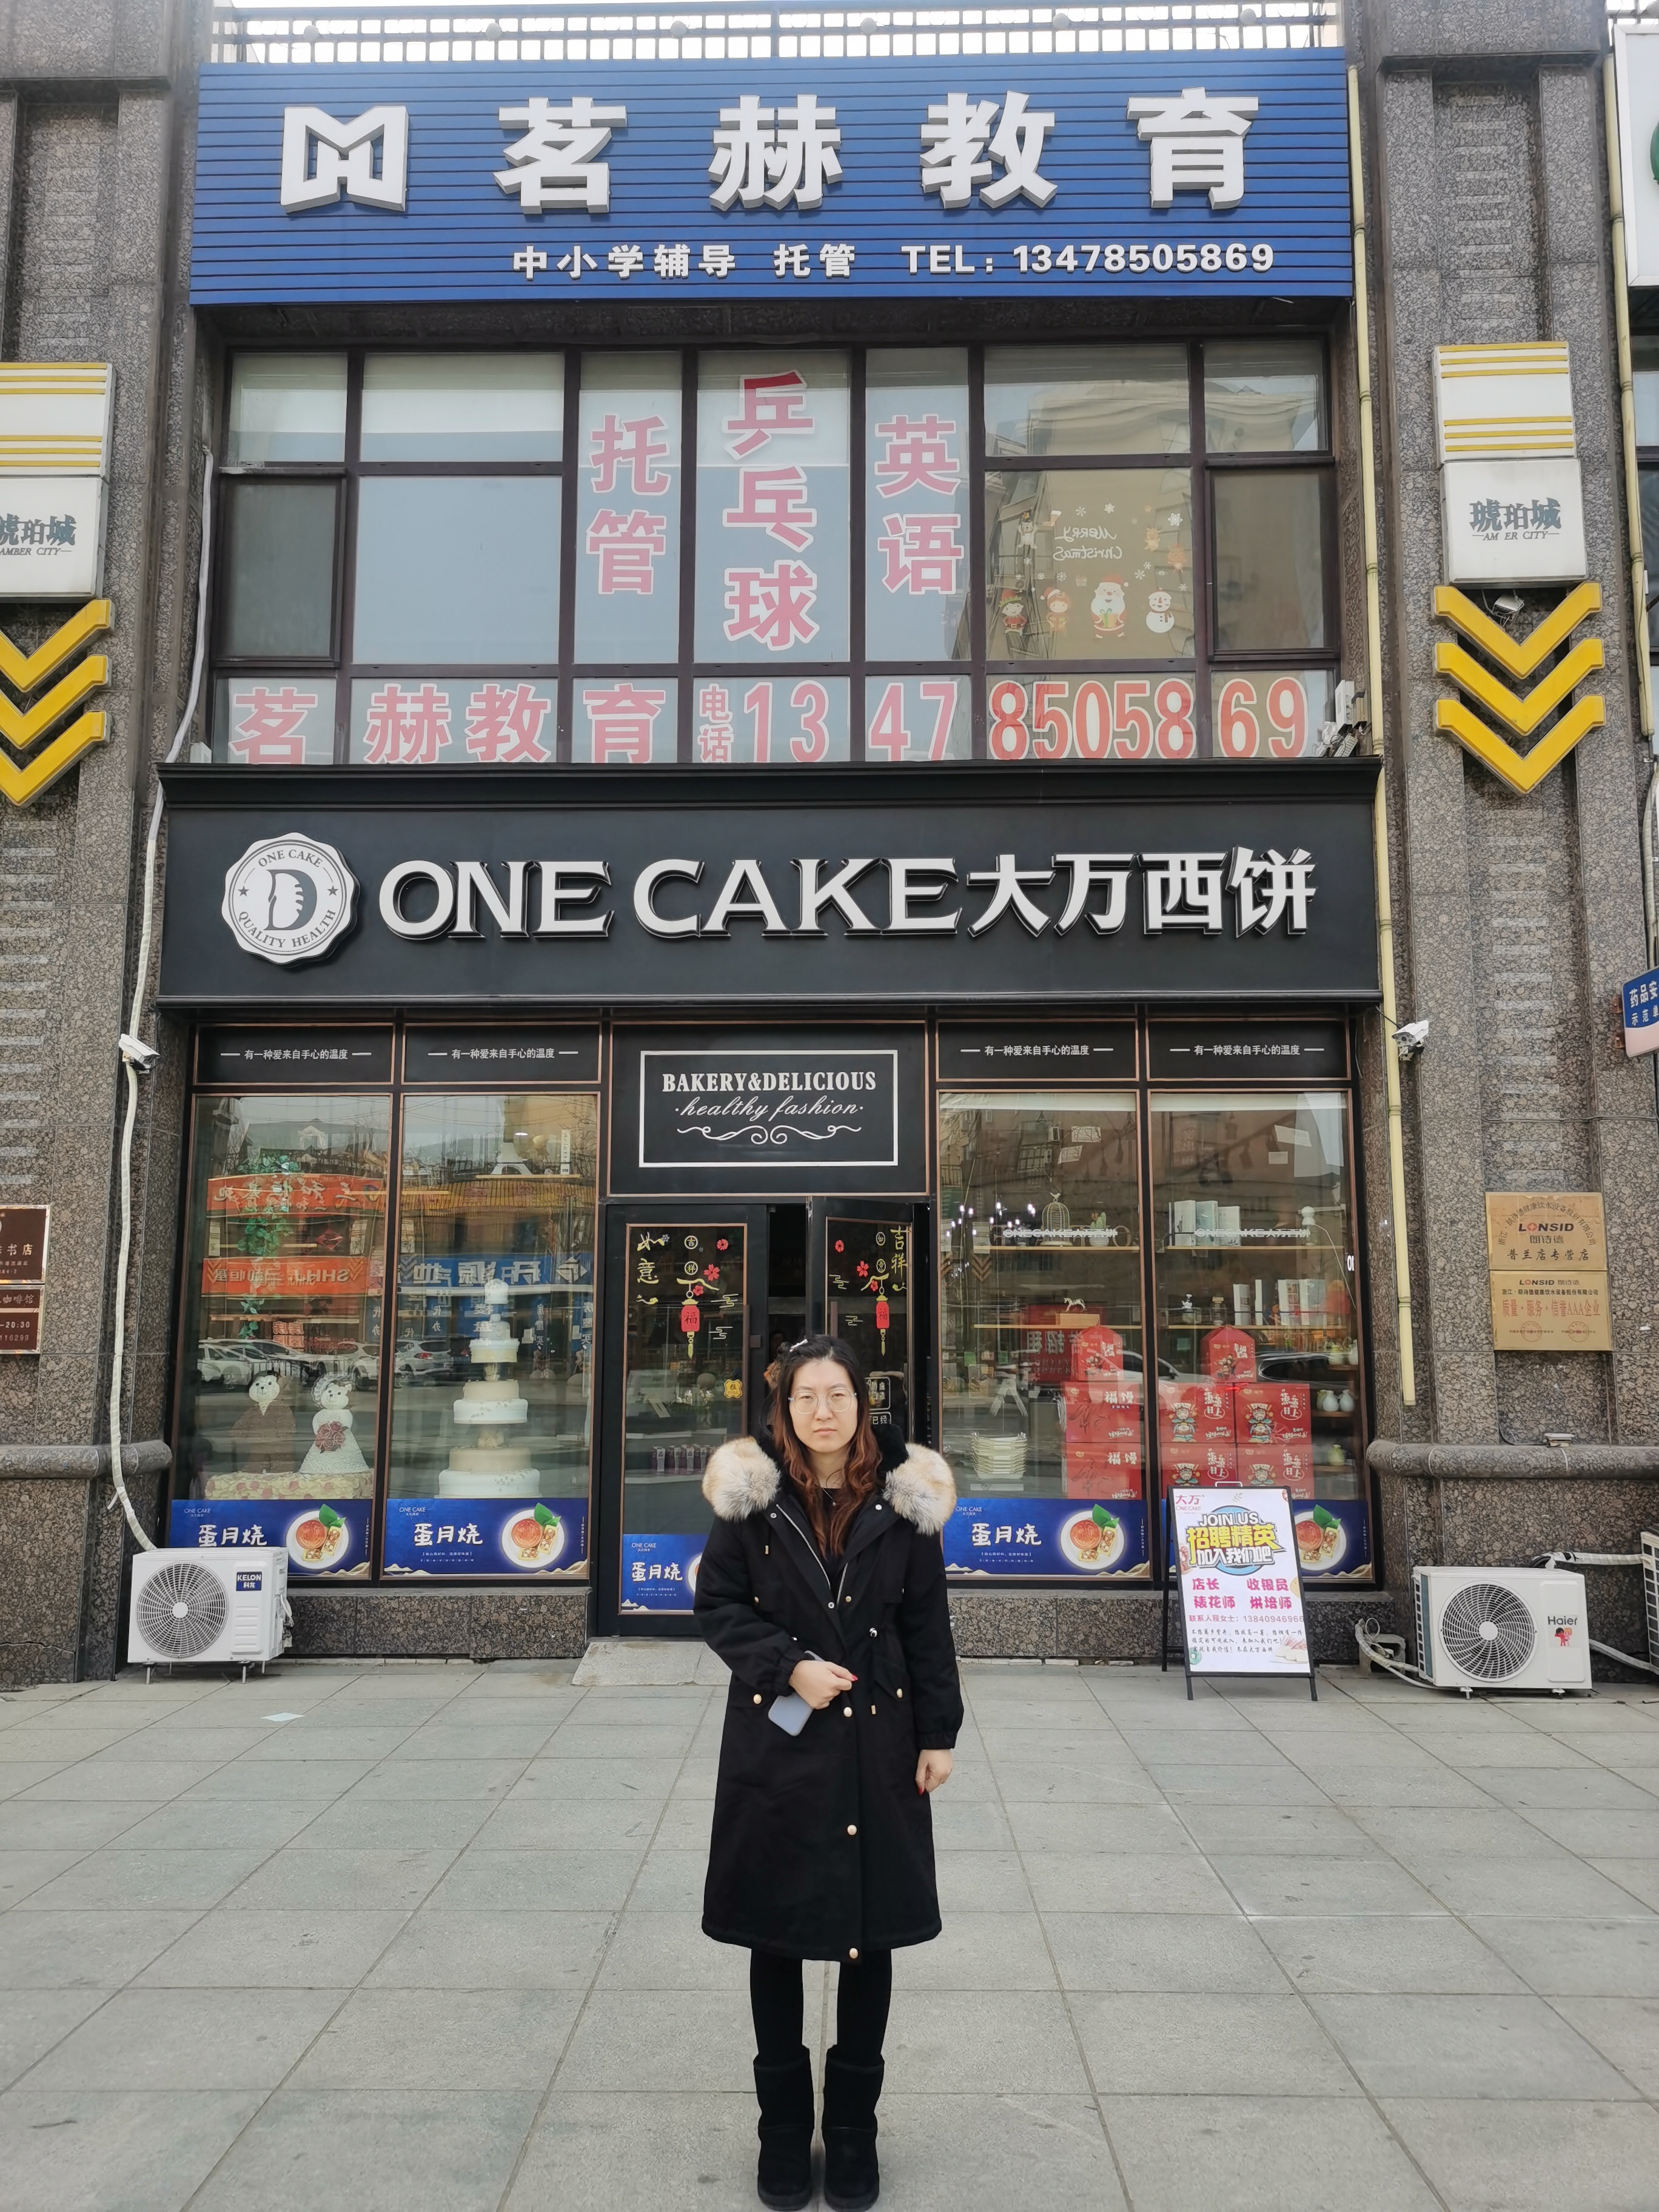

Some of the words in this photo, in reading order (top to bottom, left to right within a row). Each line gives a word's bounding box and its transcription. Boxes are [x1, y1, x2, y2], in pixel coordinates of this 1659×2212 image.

[494, 87, 1259, 214] 茗赫教育
[512, 244, 736, 281] 中小学辅导
[773, 243, 856, 278] 托管
[586, 414, 671, 594] 托管
[723, 369, 820, 651] 乒乓球
[874, 414, 964, 594] 英语
[1469, 497, 1562, 532] 琥珀城
[698, 683, 733, 763] 电话
[258, 850, 285, 867] ONE
[288, 850, 323, 867] CAKE
[379, 859, 614, 939] ONE
[633, 859, 963, 939] CAKE
[967, 845, 1317, 939] 大万西饼
[239, 911, 286, 948] QUALITY
[292, 910, 336, 948] HEALTH
[1629, 980, 1659, 1008] 药品安
[662, 1071, 877, 1092] BAKERY&DELICIOUS
[1518, 1222, 1574, 1233] LONSID
[0, 1243, 33, 1256] 书店
[0, 1293, 35, 1304] 咖啡馆
[1176, 1495, 1202, 1505] 大万
[1199, 1513, 1235, 1527] JOIN
[1238, 1512, 1259, 1525] US
[414, 1523, 483, 1546] 蛋月烧
[971, 1523, 1042, 1547] 蛋月烧
[1197, 1546, 1273, 1566] 加入我们吧
[237, 1574, 262, 1582] KELON
[632, 1562, 683, 1581] 蛋月烧
[1192, 1578, 1220, 1590] 店长
[1246, 1578, 1289, 1592] 收银员
[1547, 1615, 1578, 1626] Haier
